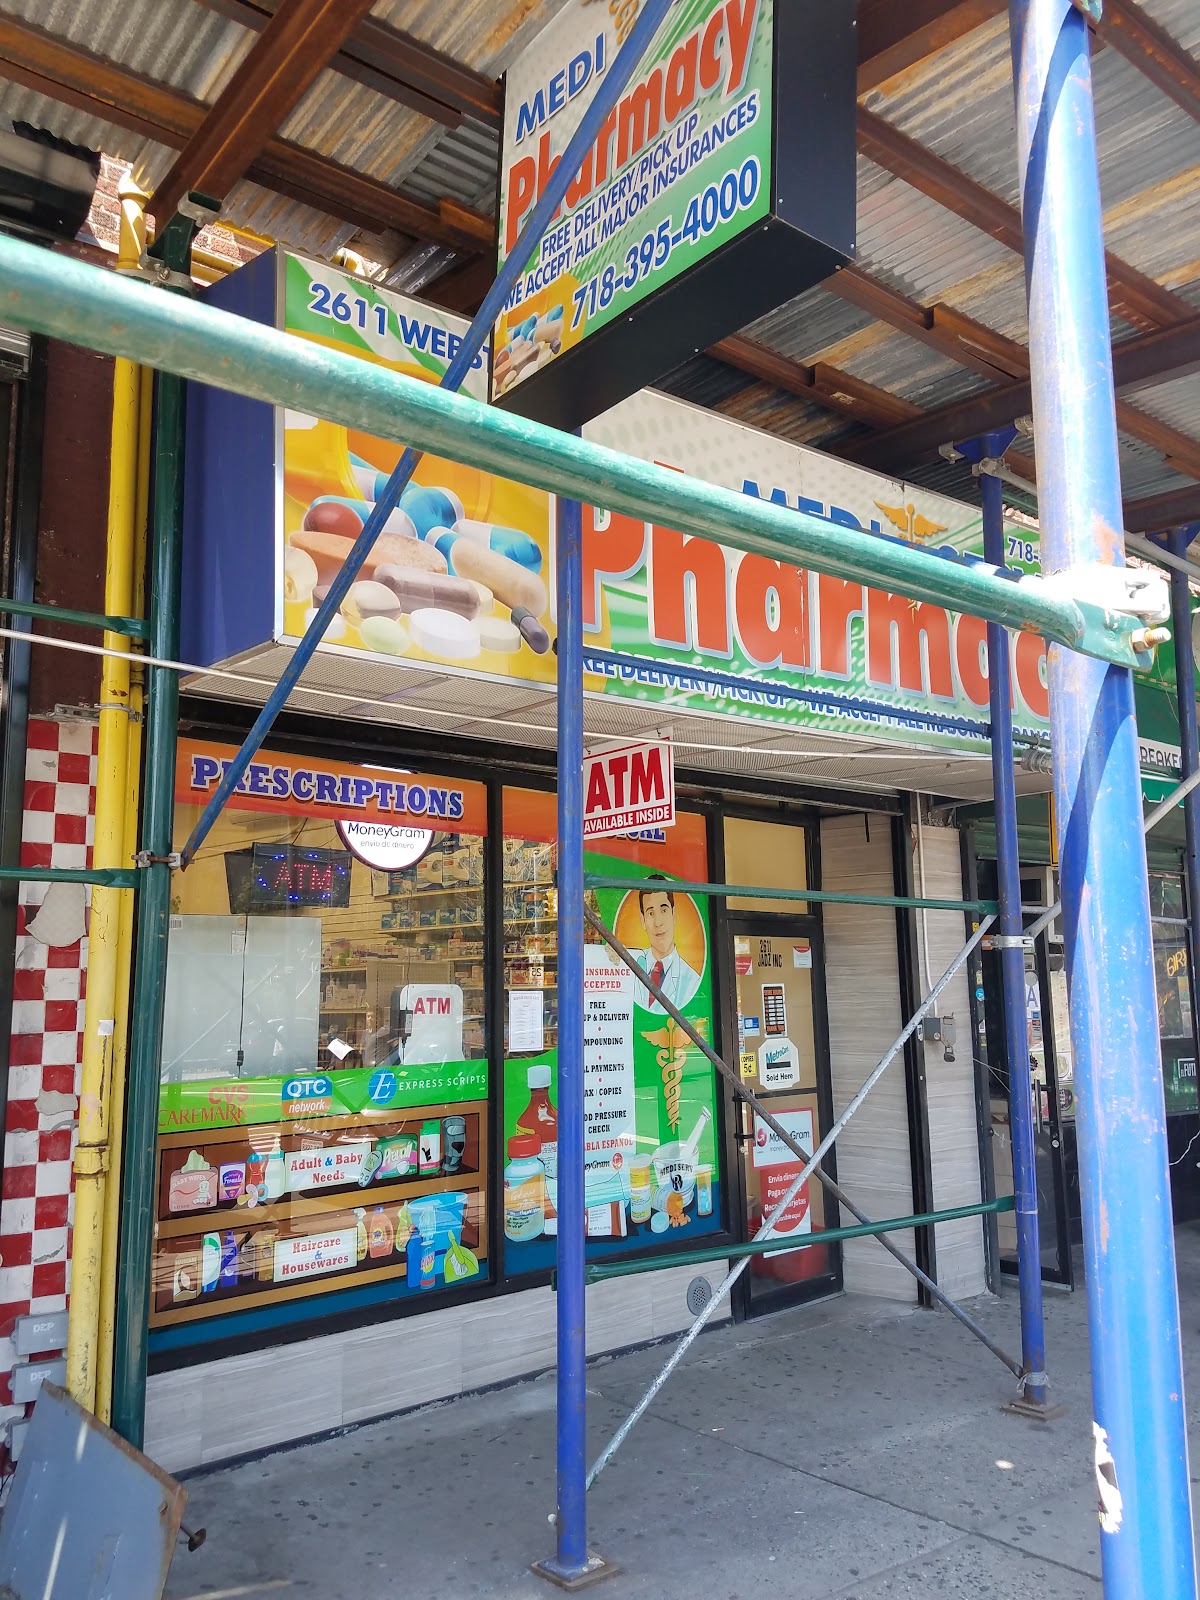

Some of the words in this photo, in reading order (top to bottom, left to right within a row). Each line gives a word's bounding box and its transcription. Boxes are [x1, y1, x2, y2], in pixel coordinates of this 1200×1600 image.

[515, 33, 605, 140] MEDI
[506, 0, 757, 254] Pharmacy
[541, 220, 571, 261] FREE
[575, 133, 672, 242] DELIVERY/PICK
[676, 113, 698, 148] UP
[524, 252, 573, 299] ACCEPT
[575, 232, 598, 264] ALL
[600, 184, 648, 243] MAJOR
[652, 94, 757, 197] INSURANCES
[572, 160, 759, 329] 718-395-4000
[311, 284, 386, 335] 2611
[399, 314, 489, 369] WEB
[1008, 537, 1041, 562] 718-
[582, 461, 1050, 722] Pharmac
[585, 747, 665, 814] ATM
[584, 815, 633, 833] AVAILABLE
[636, 806, 670, 824] INSIDE
[347, 822, 425, 839] MoneyGram
[274, 862, 333, 891] ATM
[760, 940, 771, 952] 2611
[773, 954, 782, 967] INC
[585, 968, 631, 976] INSURANCE
[413, 997, 451, 1015] ATM
[589, 1001, 606, 1009] FREE
[599, 1013, 629, 1021] DELIVERY
[584, 1037, 623, 1046] MPOUNDING
[591, 1063, 625, 1073] PAYMENTS
[286, 1078, 327, 1098] OTC
[399, 1079, 443, 1091] EXPRESS
[448, 1075, 486, 1086] SCRIPTS
[208, 1084, 249, 1104] CVS
[584, 1089, 594, 1097] AX
[599, 1087, 622, 1096] COPIES
[288, 1099, 325, 1114] network
[595, 1110, 627, 1120] PRESSURE
[588, 1124, 611, 1134] CHECK
[769, 1130, 809, 1143] MoGram
[585, 1141, 600, 1151] BLA
[290, 1157, 322, 1171] Adult
[325, 1156, 333, 1166] &
[335, 1152, 363, 1165] Baby
[585, 1159, 610, 1173] eyGram
[313, 1170, 345, 1184] Needs
[660, 1163, 676, 1176] MEDI
[783, 1172, 800, 1181] diner
[768, 1189, 781, 1198] Paga
[789, 1197, 806, 1208] arjetas
[293, 1238, 341, 1253] Haircare
[314, 1250, 322, 1260] &
[282, 1255, 349, 1275] Housewares
